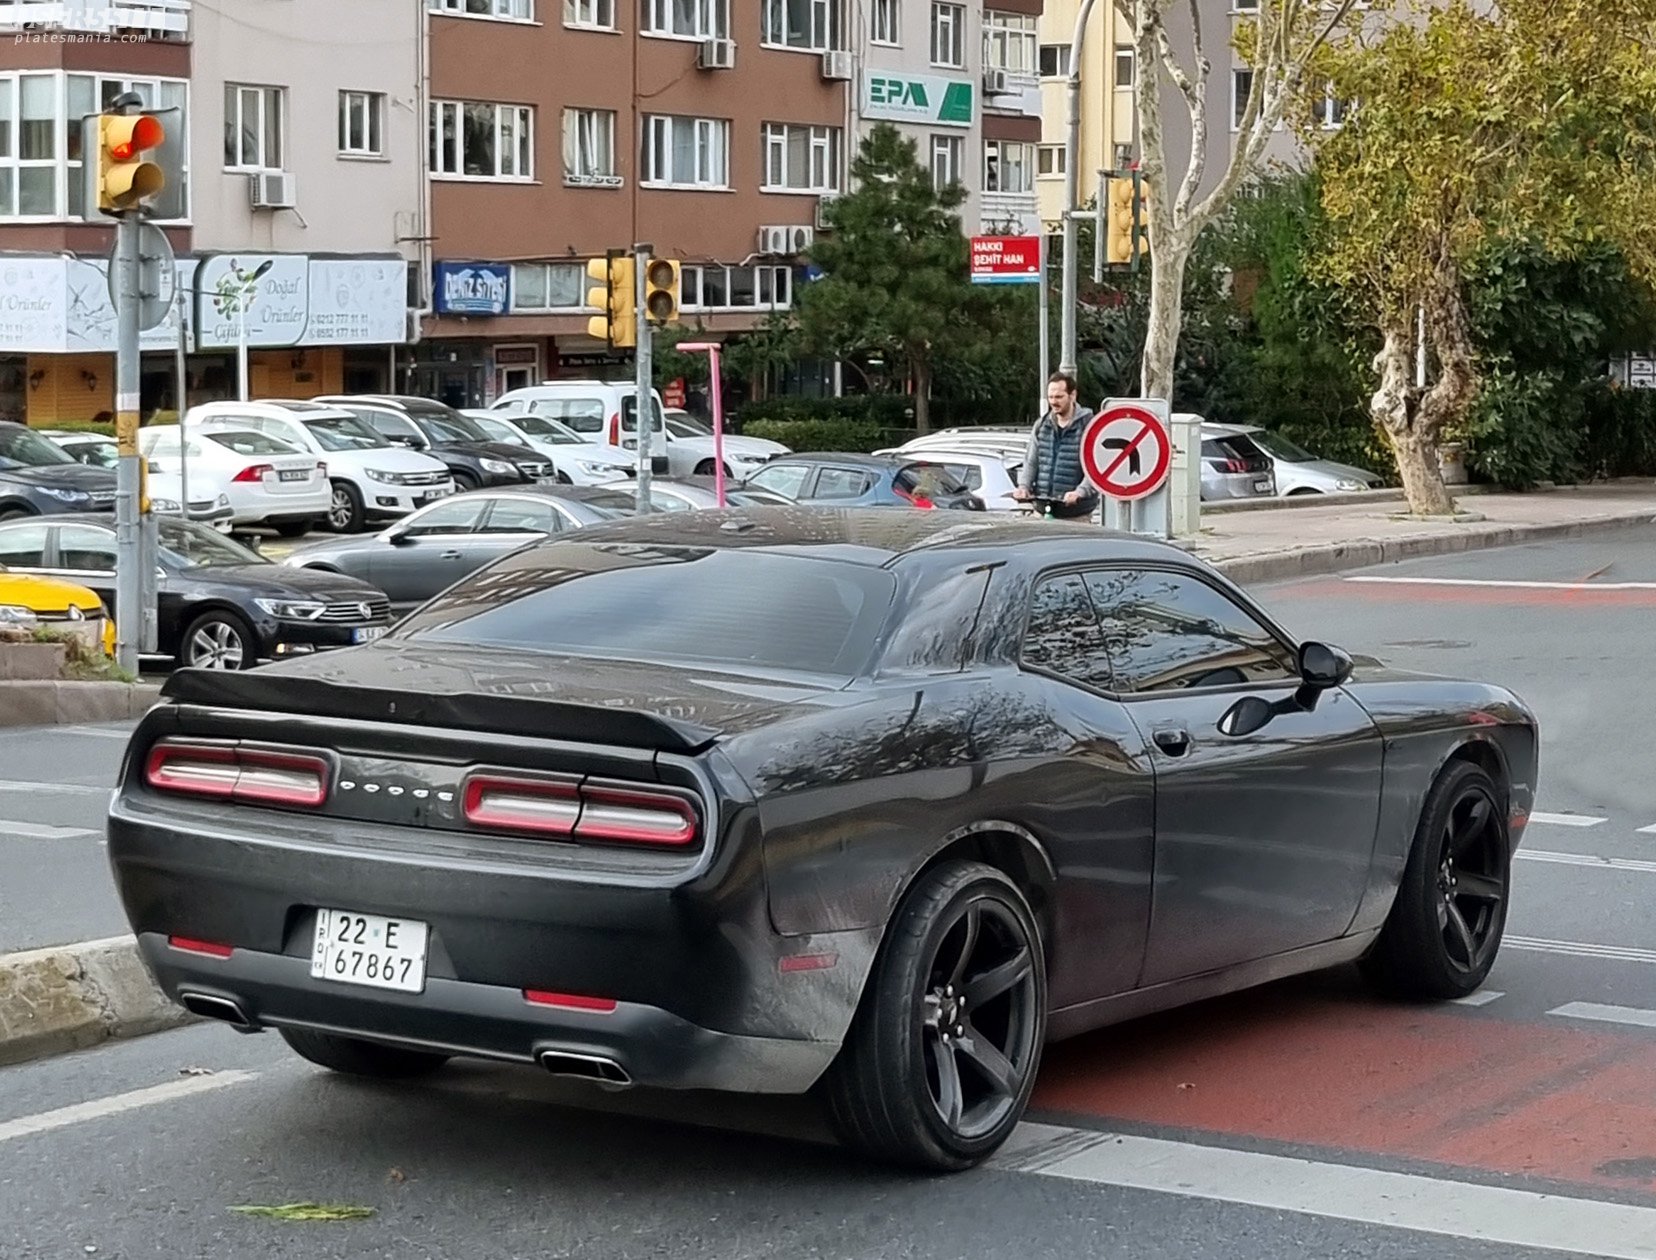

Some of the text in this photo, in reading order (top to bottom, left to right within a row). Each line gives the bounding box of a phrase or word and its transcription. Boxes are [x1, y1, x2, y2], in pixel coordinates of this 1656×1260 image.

[871, 78, 929, 107] EPA
[973, 241, 1003, 252] HAKKI
[1003, 254, 1024, 264] HAN
[338, 915, 400, 949] 22 E
[334, 949, 413, 983] 67867
